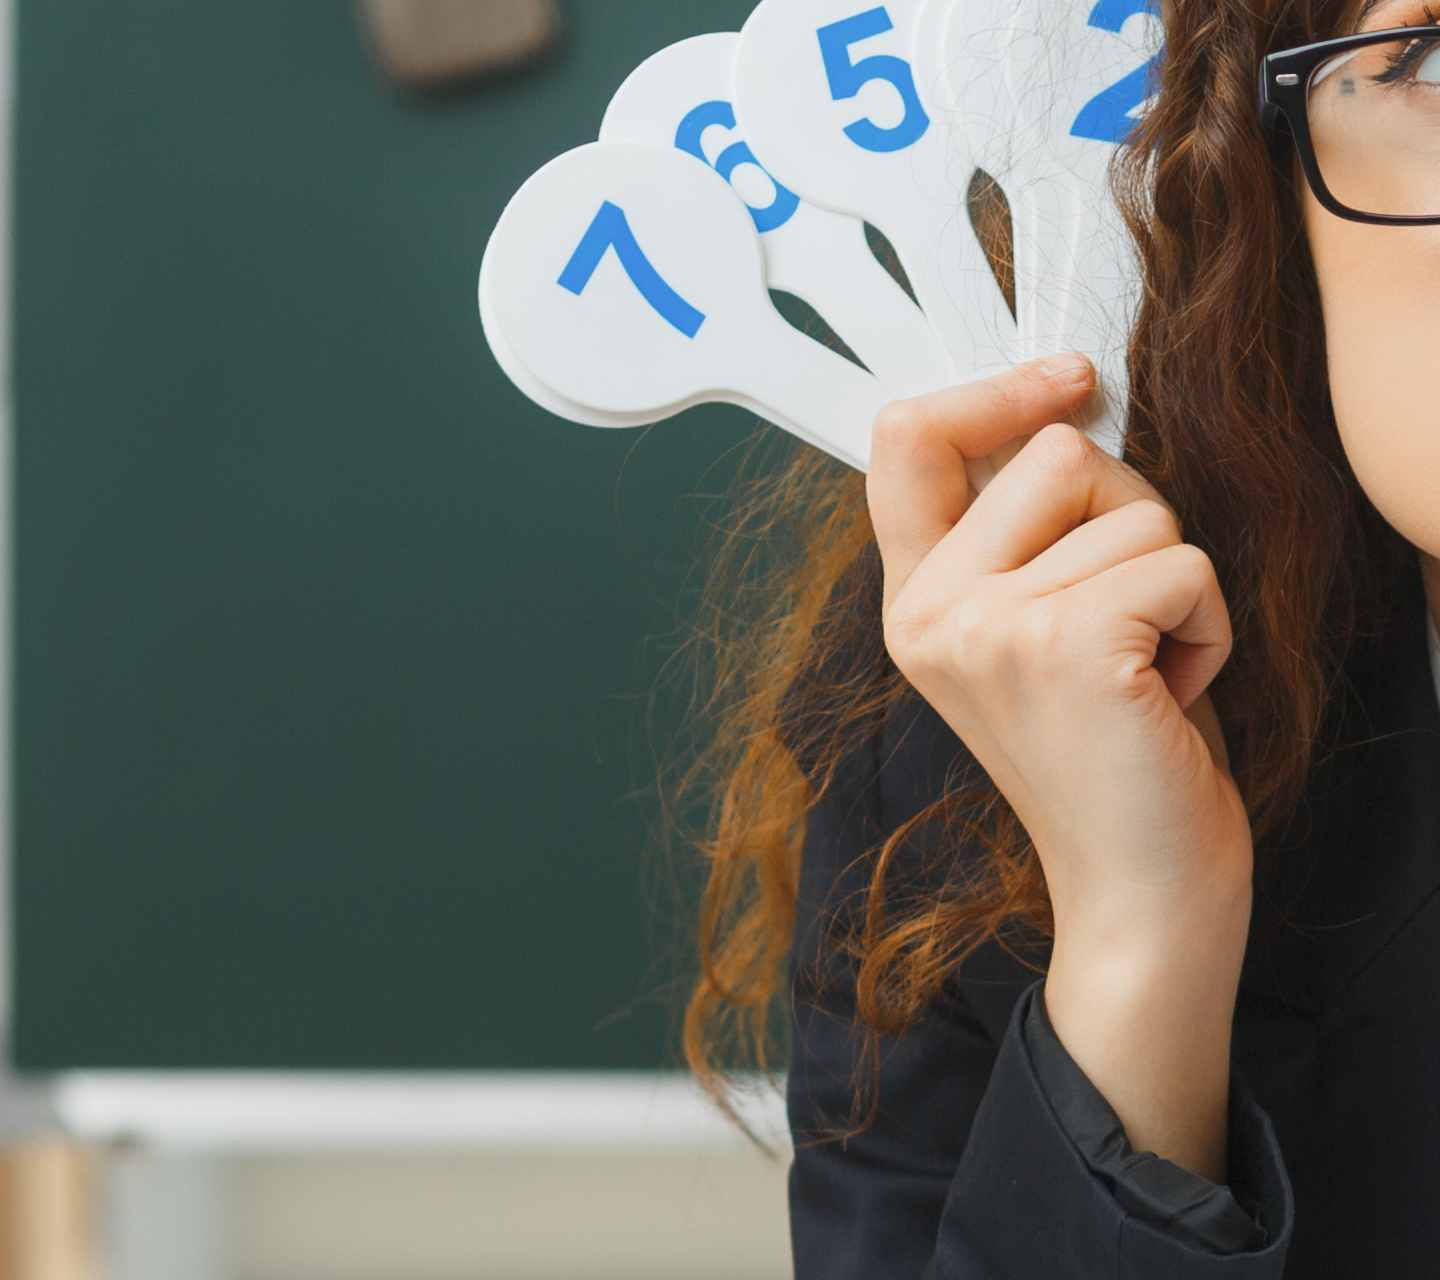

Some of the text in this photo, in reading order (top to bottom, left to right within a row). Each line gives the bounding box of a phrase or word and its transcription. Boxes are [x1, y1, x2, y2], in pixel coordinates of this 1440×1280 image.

[815, 6, 930, 153] 5
[674, 100, 801, 234] 6
[556, 200, 706, 339] 7
